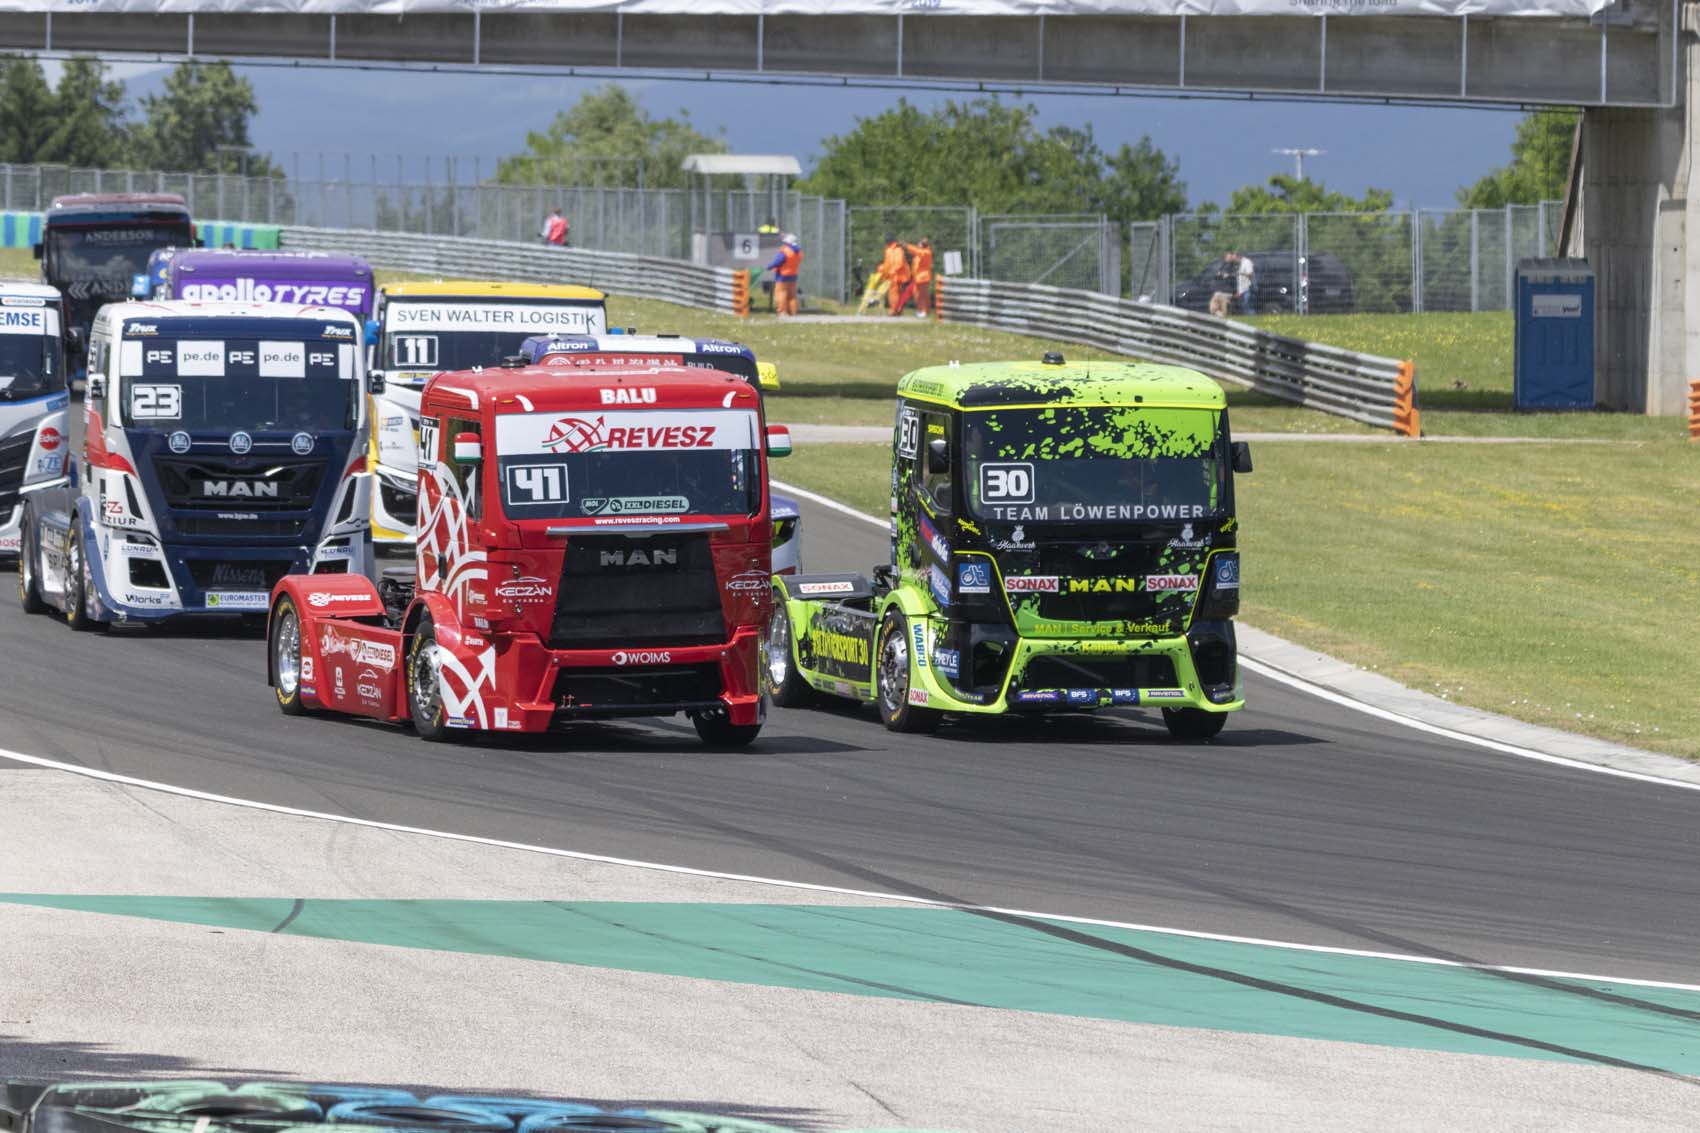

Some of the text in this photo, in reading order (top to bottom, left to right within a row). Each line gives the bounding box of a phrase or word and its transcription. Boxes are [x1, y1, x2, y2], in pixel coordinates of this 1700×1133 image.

[85, 230, 154, 241] ANDERSON
[742, 240, 752, 254] 6
[182, 278, 365, 305] apollo TYRES
[397, 309, 597, 327] SVEN WALTER LOGISTIK
[405, 338, 428, 364] 11
[547, 342, 588, 350] Altron
[702, 344, 741, 353] Altron
[183, 351, 220, 363] pe.de
[263, 353, 300, 365] pe.de
[134, 386, 178, 415] 23
[600, 388, 656, 404] BALU
[607, 426, 716, 448] REVESZ
[902, 419, 917, 450] 30
[421, 427, 433, 461] 41
[203, 481, 278, 497] MAN
[515, 468, 560, 500] 41
[986, 470, 1030, 497] 30
[644, 500, 686, 509] DIESEL
[994, 503, 1204, 520] TEAM LÖWENPOWER
[594, 516, 681, 526] www.reveszracing.com
[600, 549, 677, 566] MAN
[802, 583, 851, 592] SONAX
[1006, 578, 1057, 591] SONAX
[1069, 578, 1135, 592] MAN
[1147, 577, 1197, 589] SONAX
[220, 594, 267, 602] EUROMASTER
[1034, 624, 1061, 633] MAN
[1071, 624, 1113, 633] Service
[1127, 623, 1170, 633] Verkauf
[628, 651, 671, 664] WOIMS
[910, 689, 928, 704] SONAX
